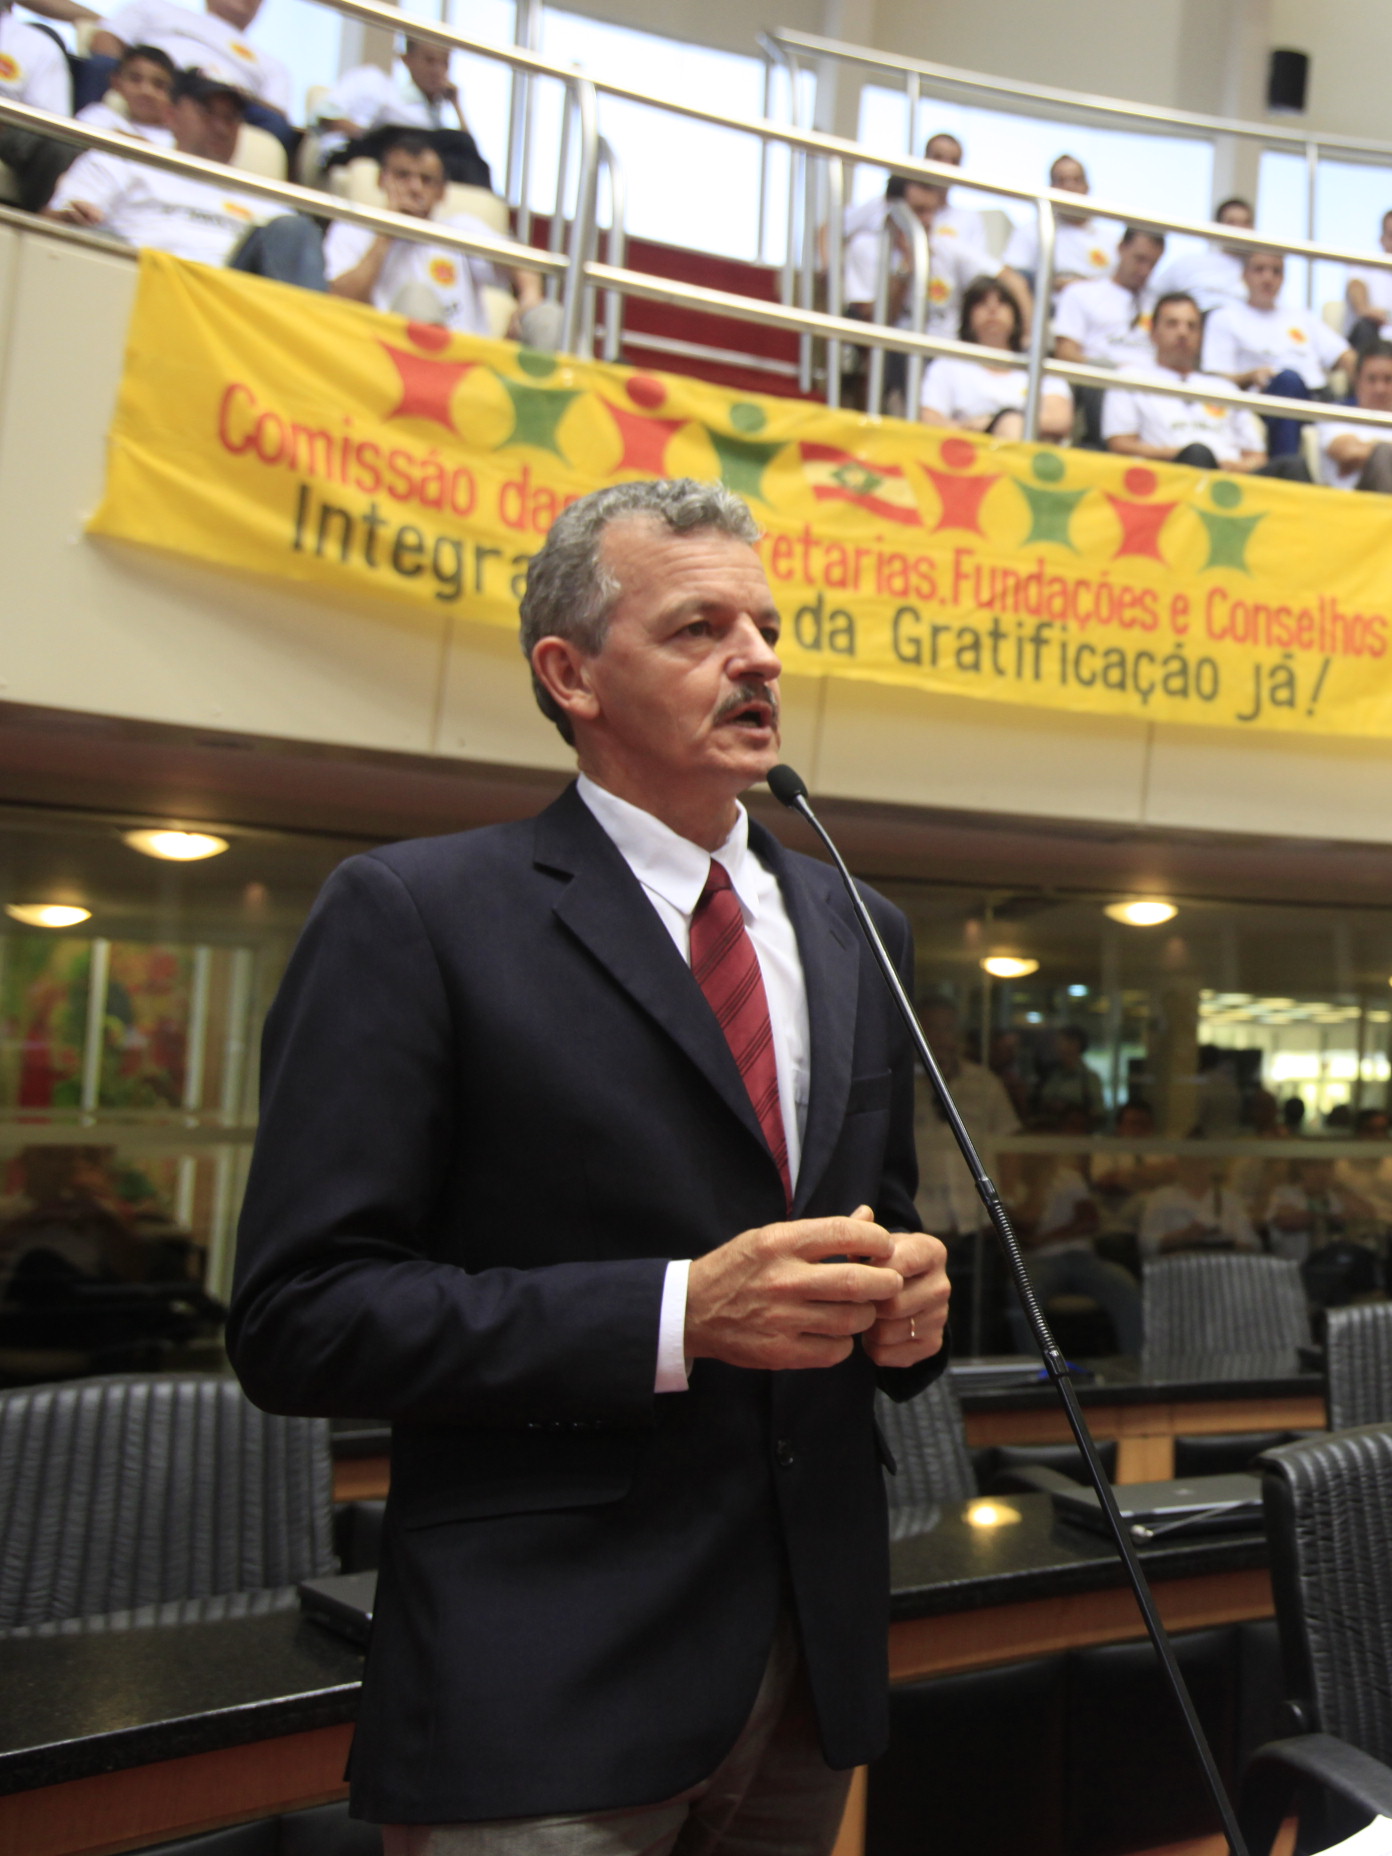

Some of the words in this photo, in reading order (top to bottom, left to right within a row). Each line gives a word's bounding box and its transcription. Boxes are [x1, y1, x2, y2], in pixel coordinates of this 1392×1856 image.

[293, 483, 529, 603] Integra
[793, 590, 857, 658] da
[892, 604, 1220, 706] Gratificação
[499, 463, 583, 536] da
[1170, 592, 1191, 636] e
[1205, 585, 1389, 660] Conselhos
